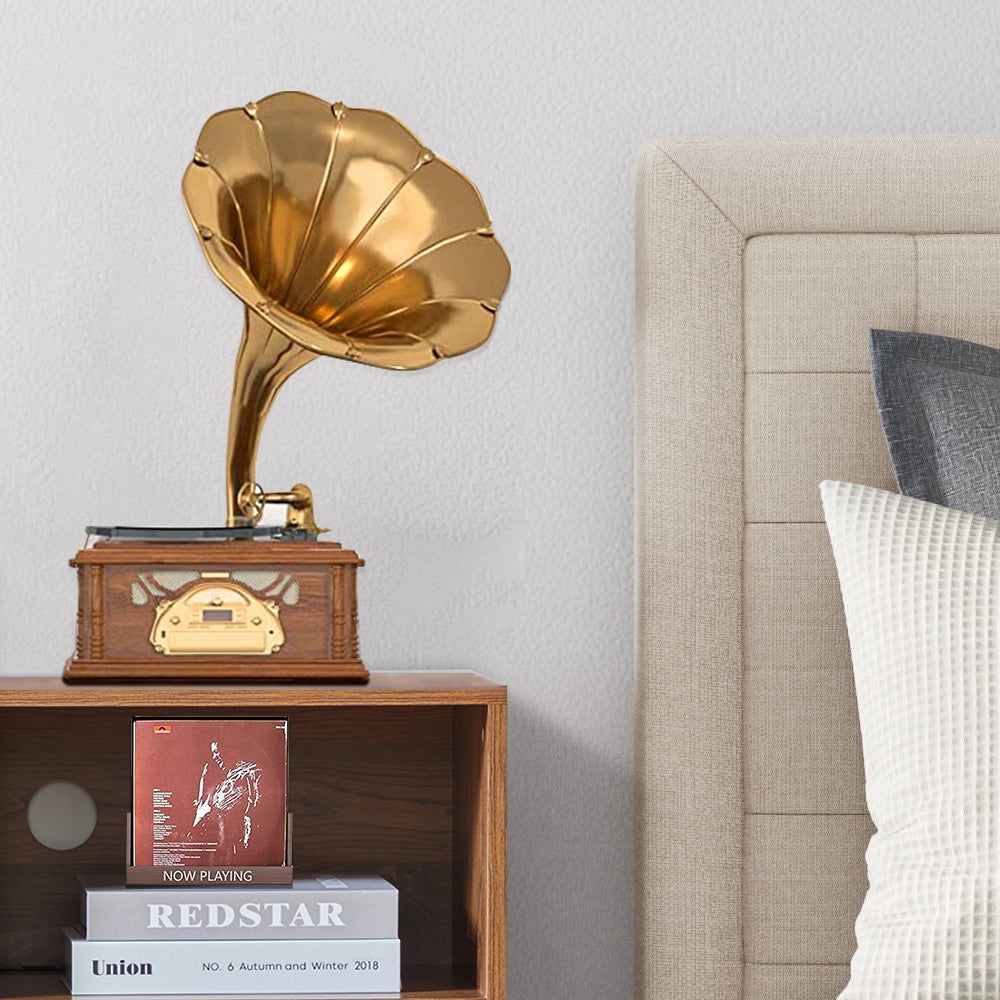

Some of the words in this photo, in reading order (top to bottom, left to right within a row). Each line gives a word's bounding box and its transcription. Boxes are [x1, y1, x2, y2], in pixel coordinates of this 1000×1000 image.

[163, 870, 197, 882] NOW
[200, 870, 253, 882] PLAYING
[146, 902, 346, 929] REDSTAR
[92, 959, 153, 976] Union
[202, 962, 222, 972] NO.
[227, 961, 235, 972] 6
[239, 961, 282, 972] Autumn
[284, 961, 307, 971] and
[311, 961, 349, 971] Winter
[354, 960, 380, 971] 2018
